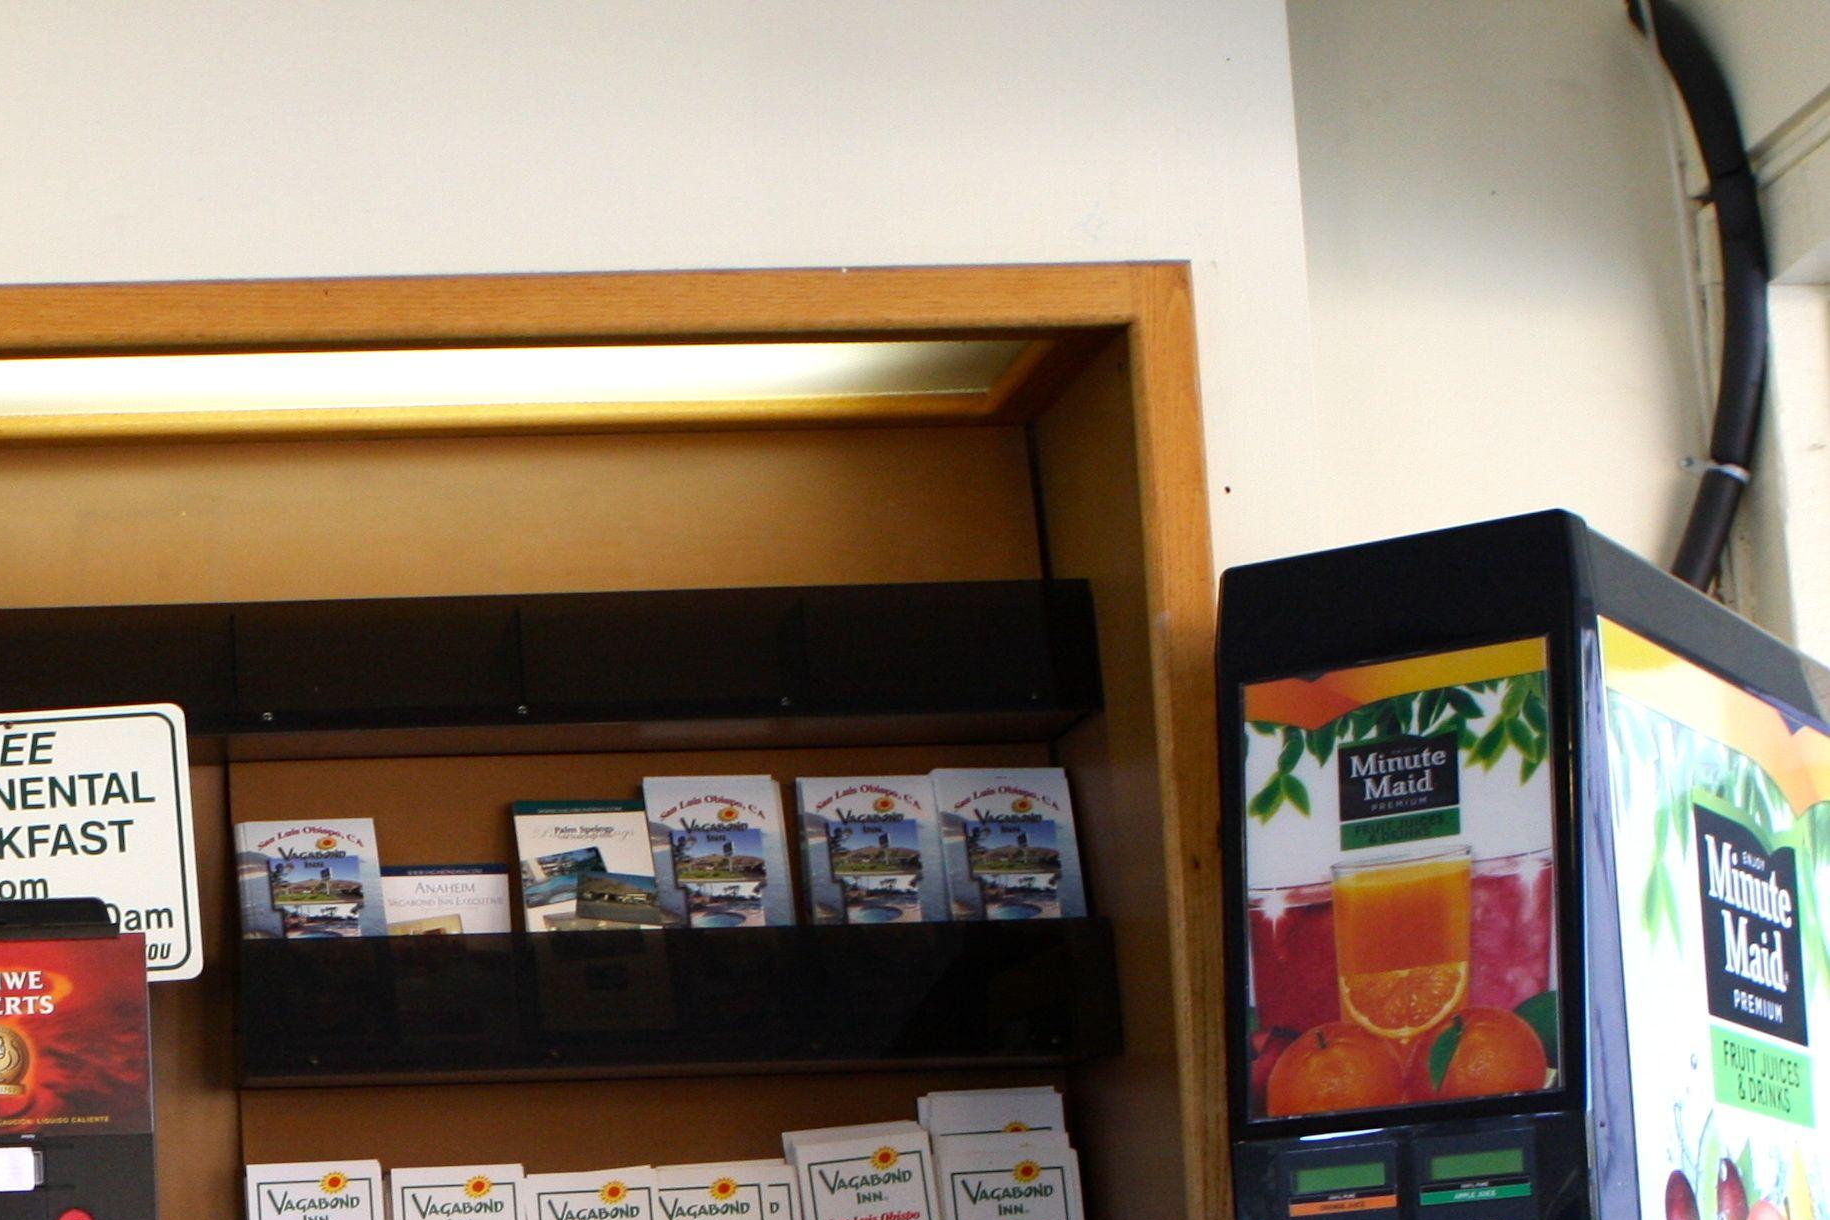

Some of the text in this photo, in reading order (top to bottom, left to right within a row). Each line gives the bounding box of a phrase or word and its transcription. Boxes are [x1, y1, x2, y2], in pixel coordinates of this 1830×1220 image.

[1350, 748, 1447, 778] Minute
[1364, 770, 1433, 801] Maid
[1371, 797, 1428, 812] PREMIUM
[278, 847, 347, 862] VAGABOND
[1742, 851, 1765, 872] ENJOY
[415, 881, 475, 894] ANAHEIM
[1704, 833, 1793, 929] Minute
[1721, 910, 1787, 993] Maid
[1733, 989, 1783, 1023] PREMIUM
[1723, 1040, 1800, 1088] FRUIT JUICES
[1737, 1074, 1791, 1113] & DRINKS
[819, 1167, 912, 1194] VAGABOND
[962, 1180, 1054, 1204] VAGABOND
[267, 1190, 360, 1215] VAGABOND
[411, 1193, 504, 1219] VAGABOND
